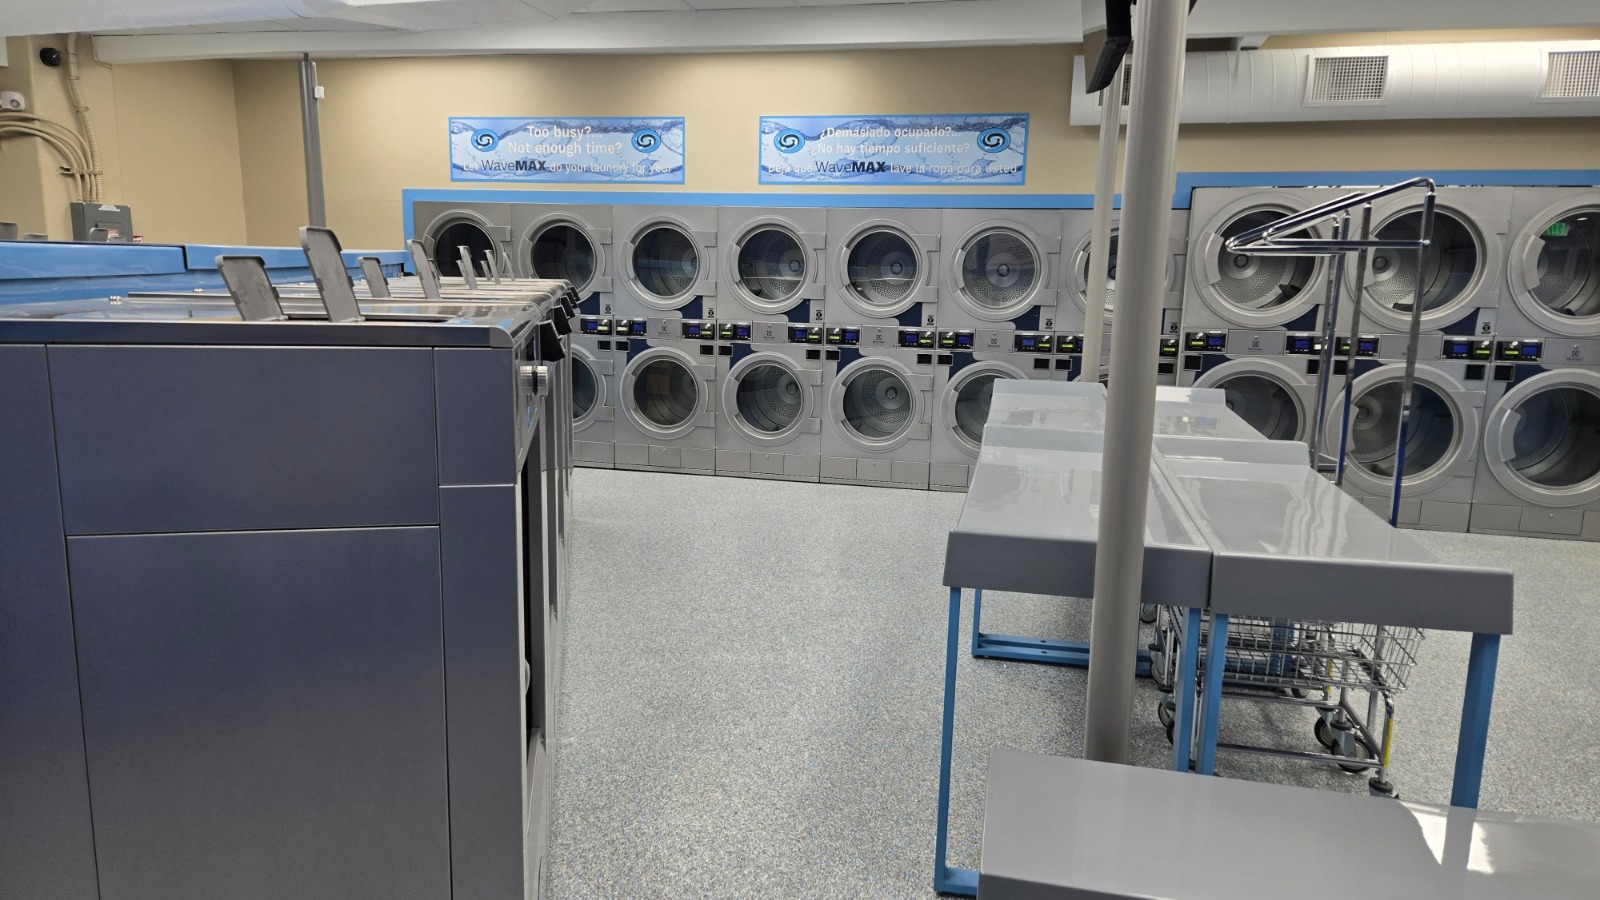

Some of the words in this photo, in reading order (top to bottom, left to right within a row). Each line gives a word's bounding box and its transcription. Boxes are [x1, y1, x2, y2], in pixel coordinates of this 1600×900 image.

[527, 126, 550, 138] Too
[820, 127, 892, 140] ¿Demasiado
[508, 142, 530, 154] Not
[535, 141, 582, 157] enough
[585, 141, 623, 154] time?
[811, 143, 832, 156] ¿No
[836, 143, 857, 156] hay
[859, 143, 901, 156] tiempo
[904, 142, 970, 155] suficiente?
[463, 162, 479, 171] Let
[481, 159, 547, 171] WaveMAX
[549, 162, 562, 172] do
[565, 164, 586, 174] your
[590, 163, 629, 174] laundry
[632, 163, 646, 173] for
[649, 164, 671, 174] you!
[768, 163, 790, 175] Deja
[793, 164, 813, 175] que
[814, 160, 886, 173] WaveMAX
[890, 162, 912, 173] lave
[915, 162, 925, 173] la
[928, 164, 954, 176] ropa
[957, 164, 981, 175] para
[985, 163, 1017, 174] usted
